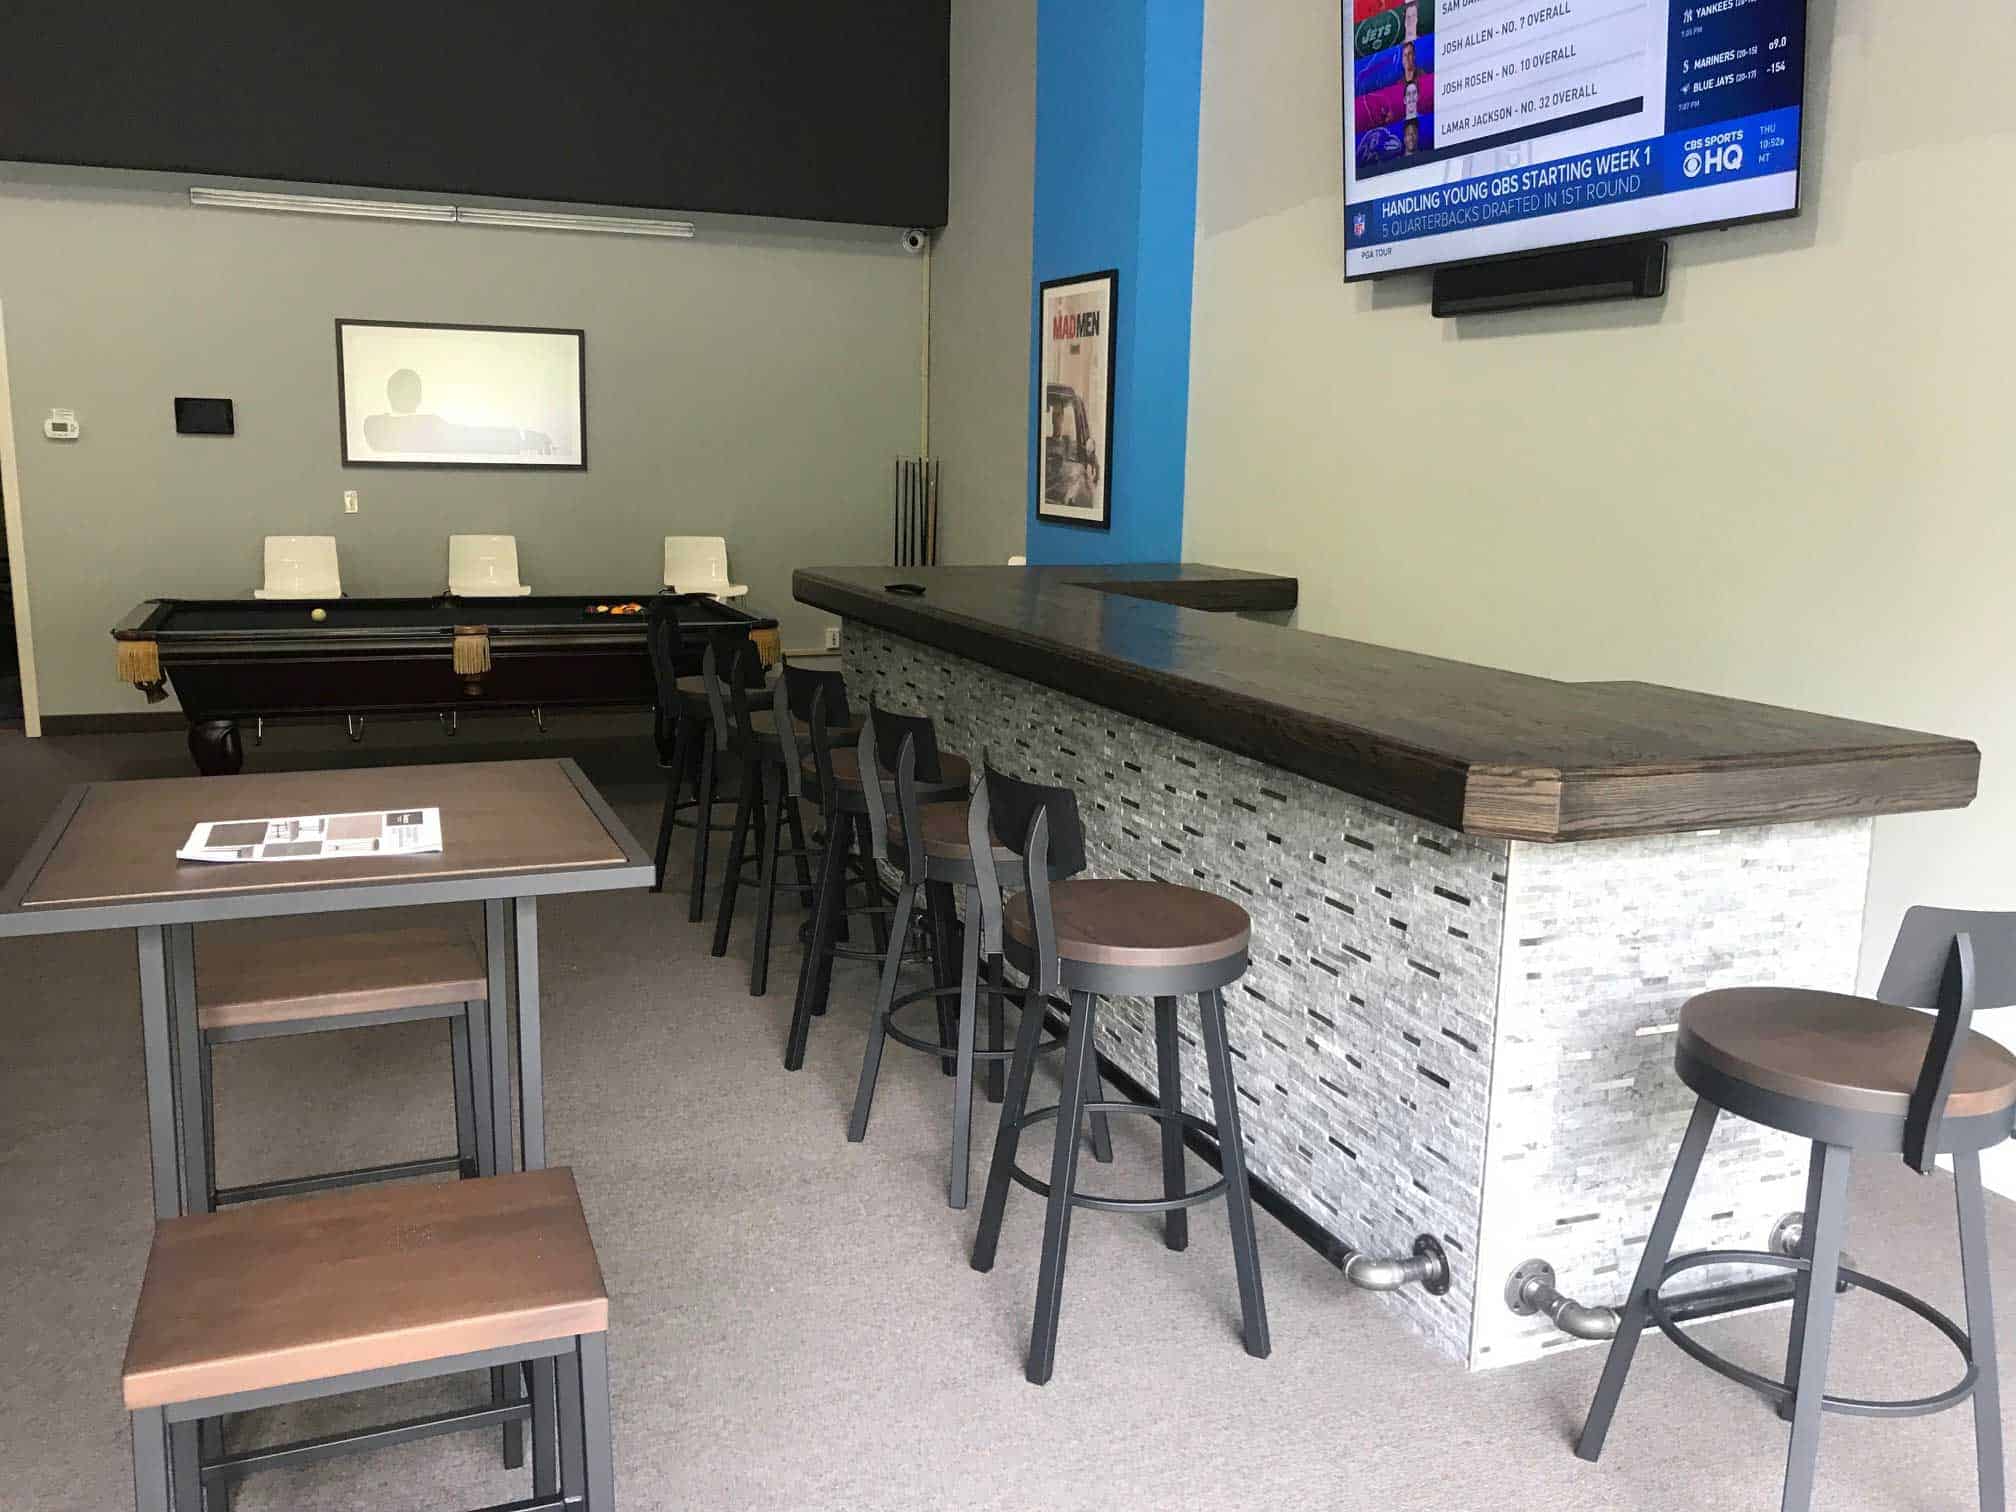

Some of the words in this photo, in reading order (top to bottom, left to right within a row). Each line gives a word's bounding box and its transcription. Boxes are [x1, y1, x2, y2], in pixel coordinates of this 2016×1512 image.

[1442, 0, 1460, 15] SAM
[1695, 0, 1734, 18] YANKEES
[1362, 24, 1392, 44] JETS
[1442, 38, 1463, 56] JOSH
[1465, 28, 1493, 48] ALLEN
[1501, 21, 1517, 35] NO.
[1520, 16, 1525, 29] 7
[1527, 1, 1571, 26] OVERALL
[1441, 78, 1463, 96] JOSH
[1464, 69, 1493, 89] ROSEN
[1502, 63, 1517, 78] NO.
[1520, 58, 1530, 72] 10
[1532, 44, 1576, 68] OVERALL
[1694, 50, 1735, 70] MARINERS
[1766, 61, 1786, 74] -154
[1441, 118, 1470, 136] LAMAR
[1472, 105, 1512, 130] JACKSON
[1520, 100, 1536, 115] NO.
[1539, 95, 1550, 110] 32
[1552, 83, 1597, 106] OVERALL
[1760, 123, 1776, 135] THU
[1684, 138, 1703, 151] CBS
[1704, 130, 1744, 147] SPORTS
[1704, 144, 1743, 174] HQ
[1758, 152, 1770, 164] MT
[1382, 191, 1440, 218] HANDLING
[1442, 182, 1488, 205] YOUNG
[1491, 174, 1519, 196] QBS
[1522, 159, 1592, 190] STARTING
[1596, 147, 1640, 175] WEEK
[1643, 145, 1651, 166] 1
[1382, 223, 1389, 239] 5
[1391, 206, 1479, 236] QUARTERBACKS
[1482, 194, 1540, 220] DRAFTED
[1544, 191, 1558, 209] IN
[1561, 185, 1582, 205] 1ST
[1586, 174, 1641, 201] ROUND
[1361, 249, 1374, 259] PGA
[1375, 247, 1392, 257] TOUR
